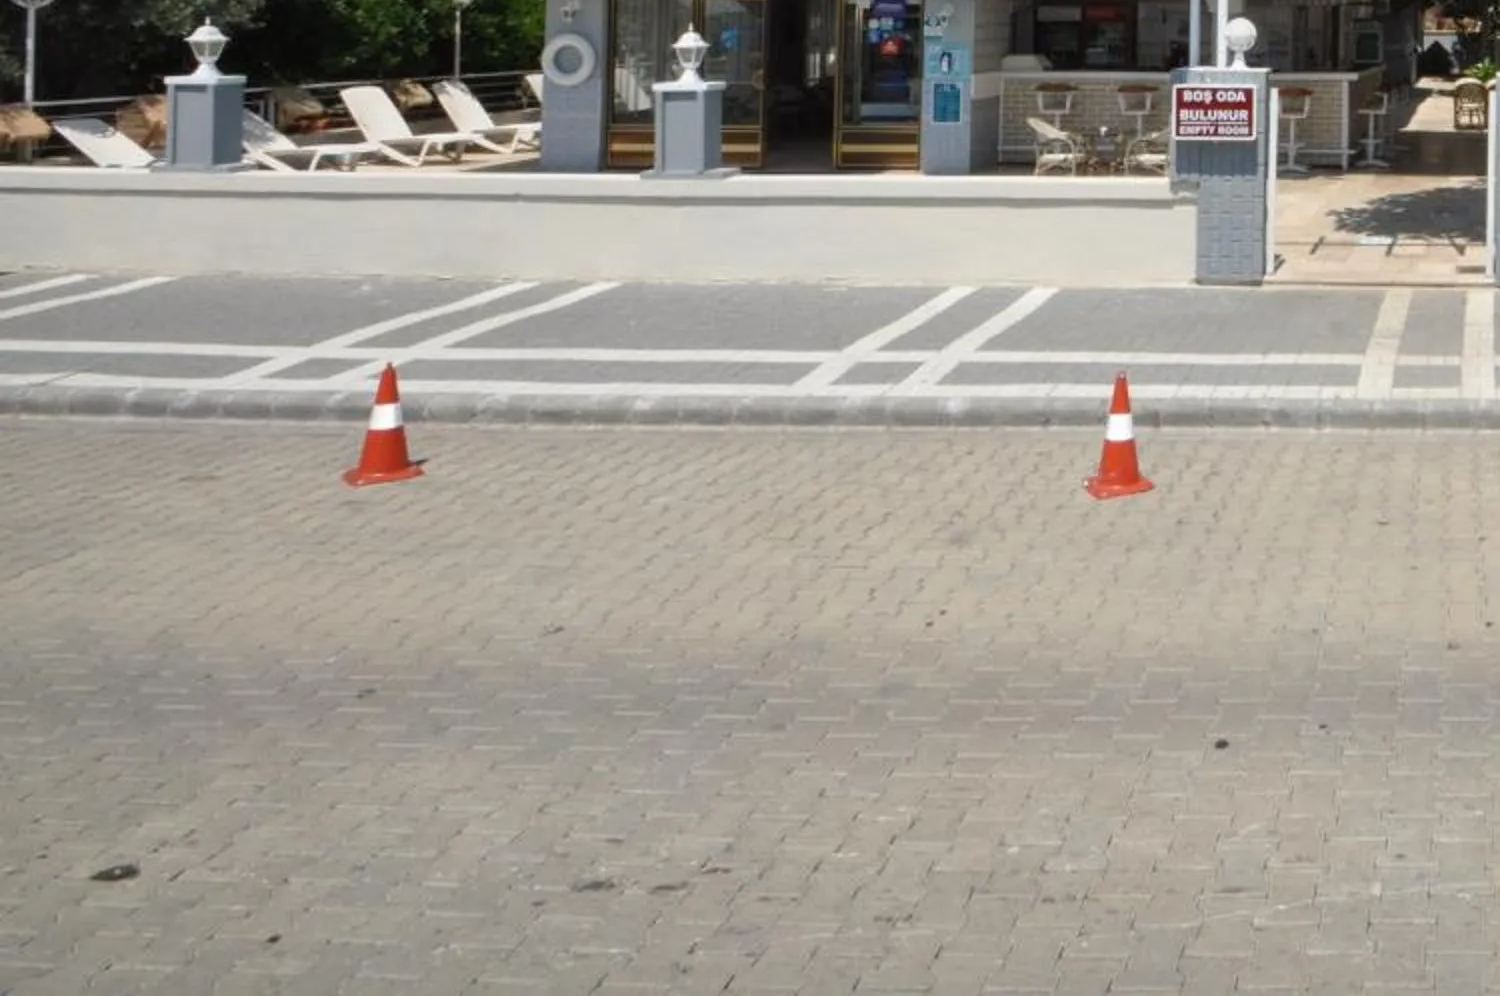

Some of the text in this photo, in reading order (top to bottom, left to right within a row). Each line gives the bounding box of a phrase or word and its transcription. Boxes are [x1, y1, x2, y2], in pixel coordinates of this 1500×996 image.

[1183, 90, 1246, 104] BOŞ ODA
[1180, 108, 1248, 120] BULUNUR
